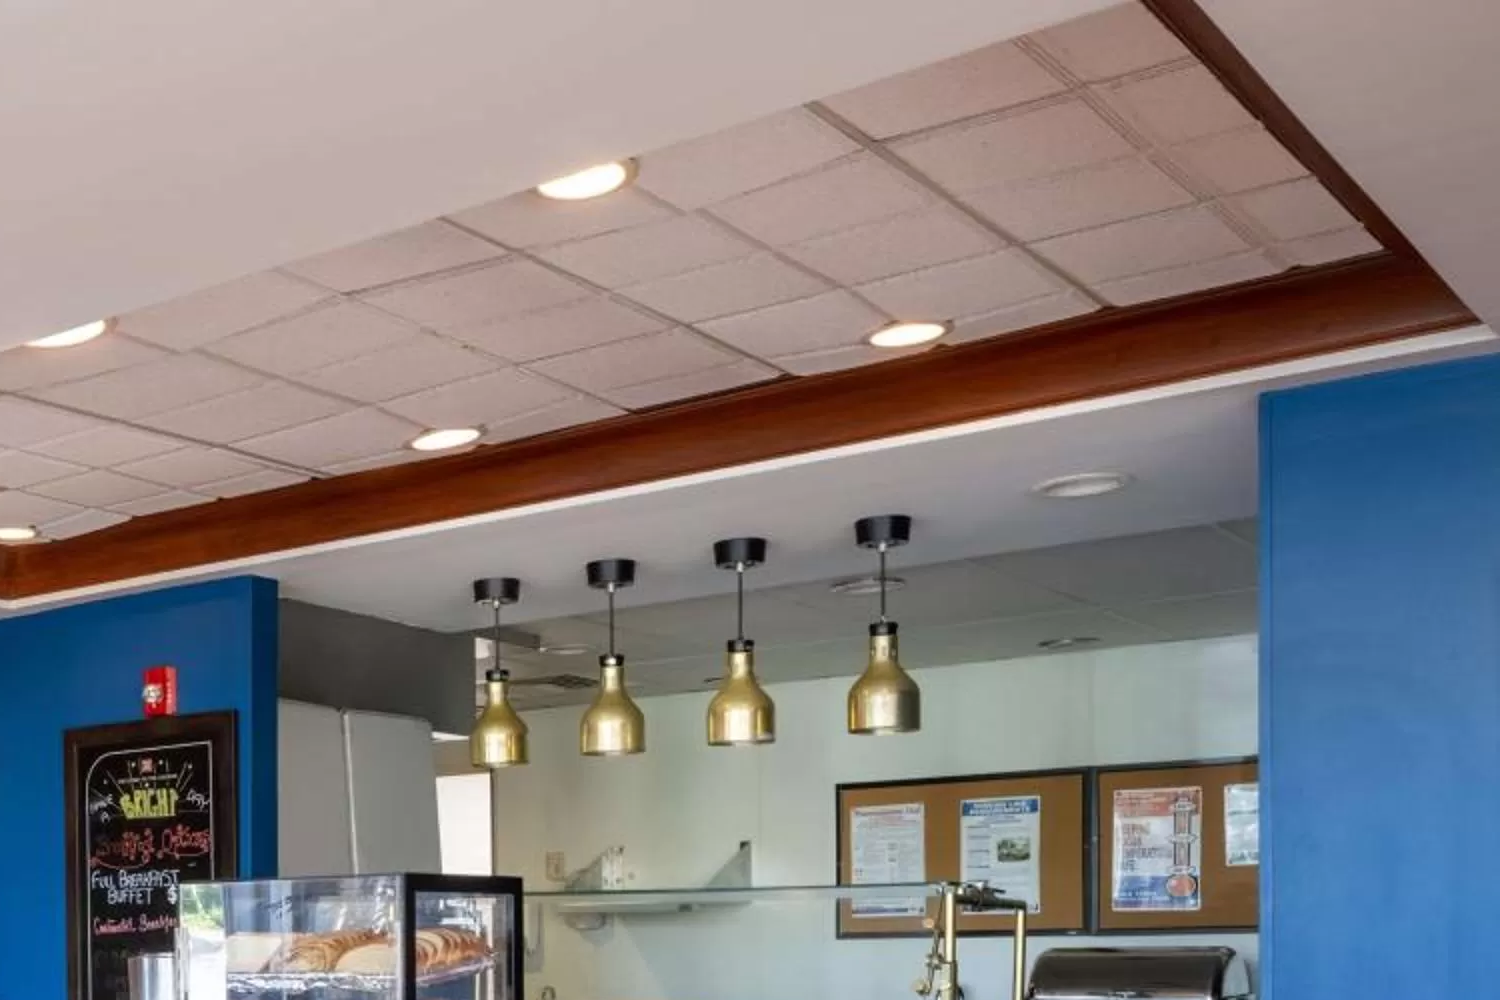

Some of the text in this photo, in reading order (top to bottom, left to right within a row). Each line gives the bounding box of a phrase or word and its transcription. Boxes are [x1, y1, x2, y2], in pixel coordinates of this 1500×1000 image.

[118, 869, 181, 888] BREAKFAST
[106, 884, 178, 906] BUFFET $
